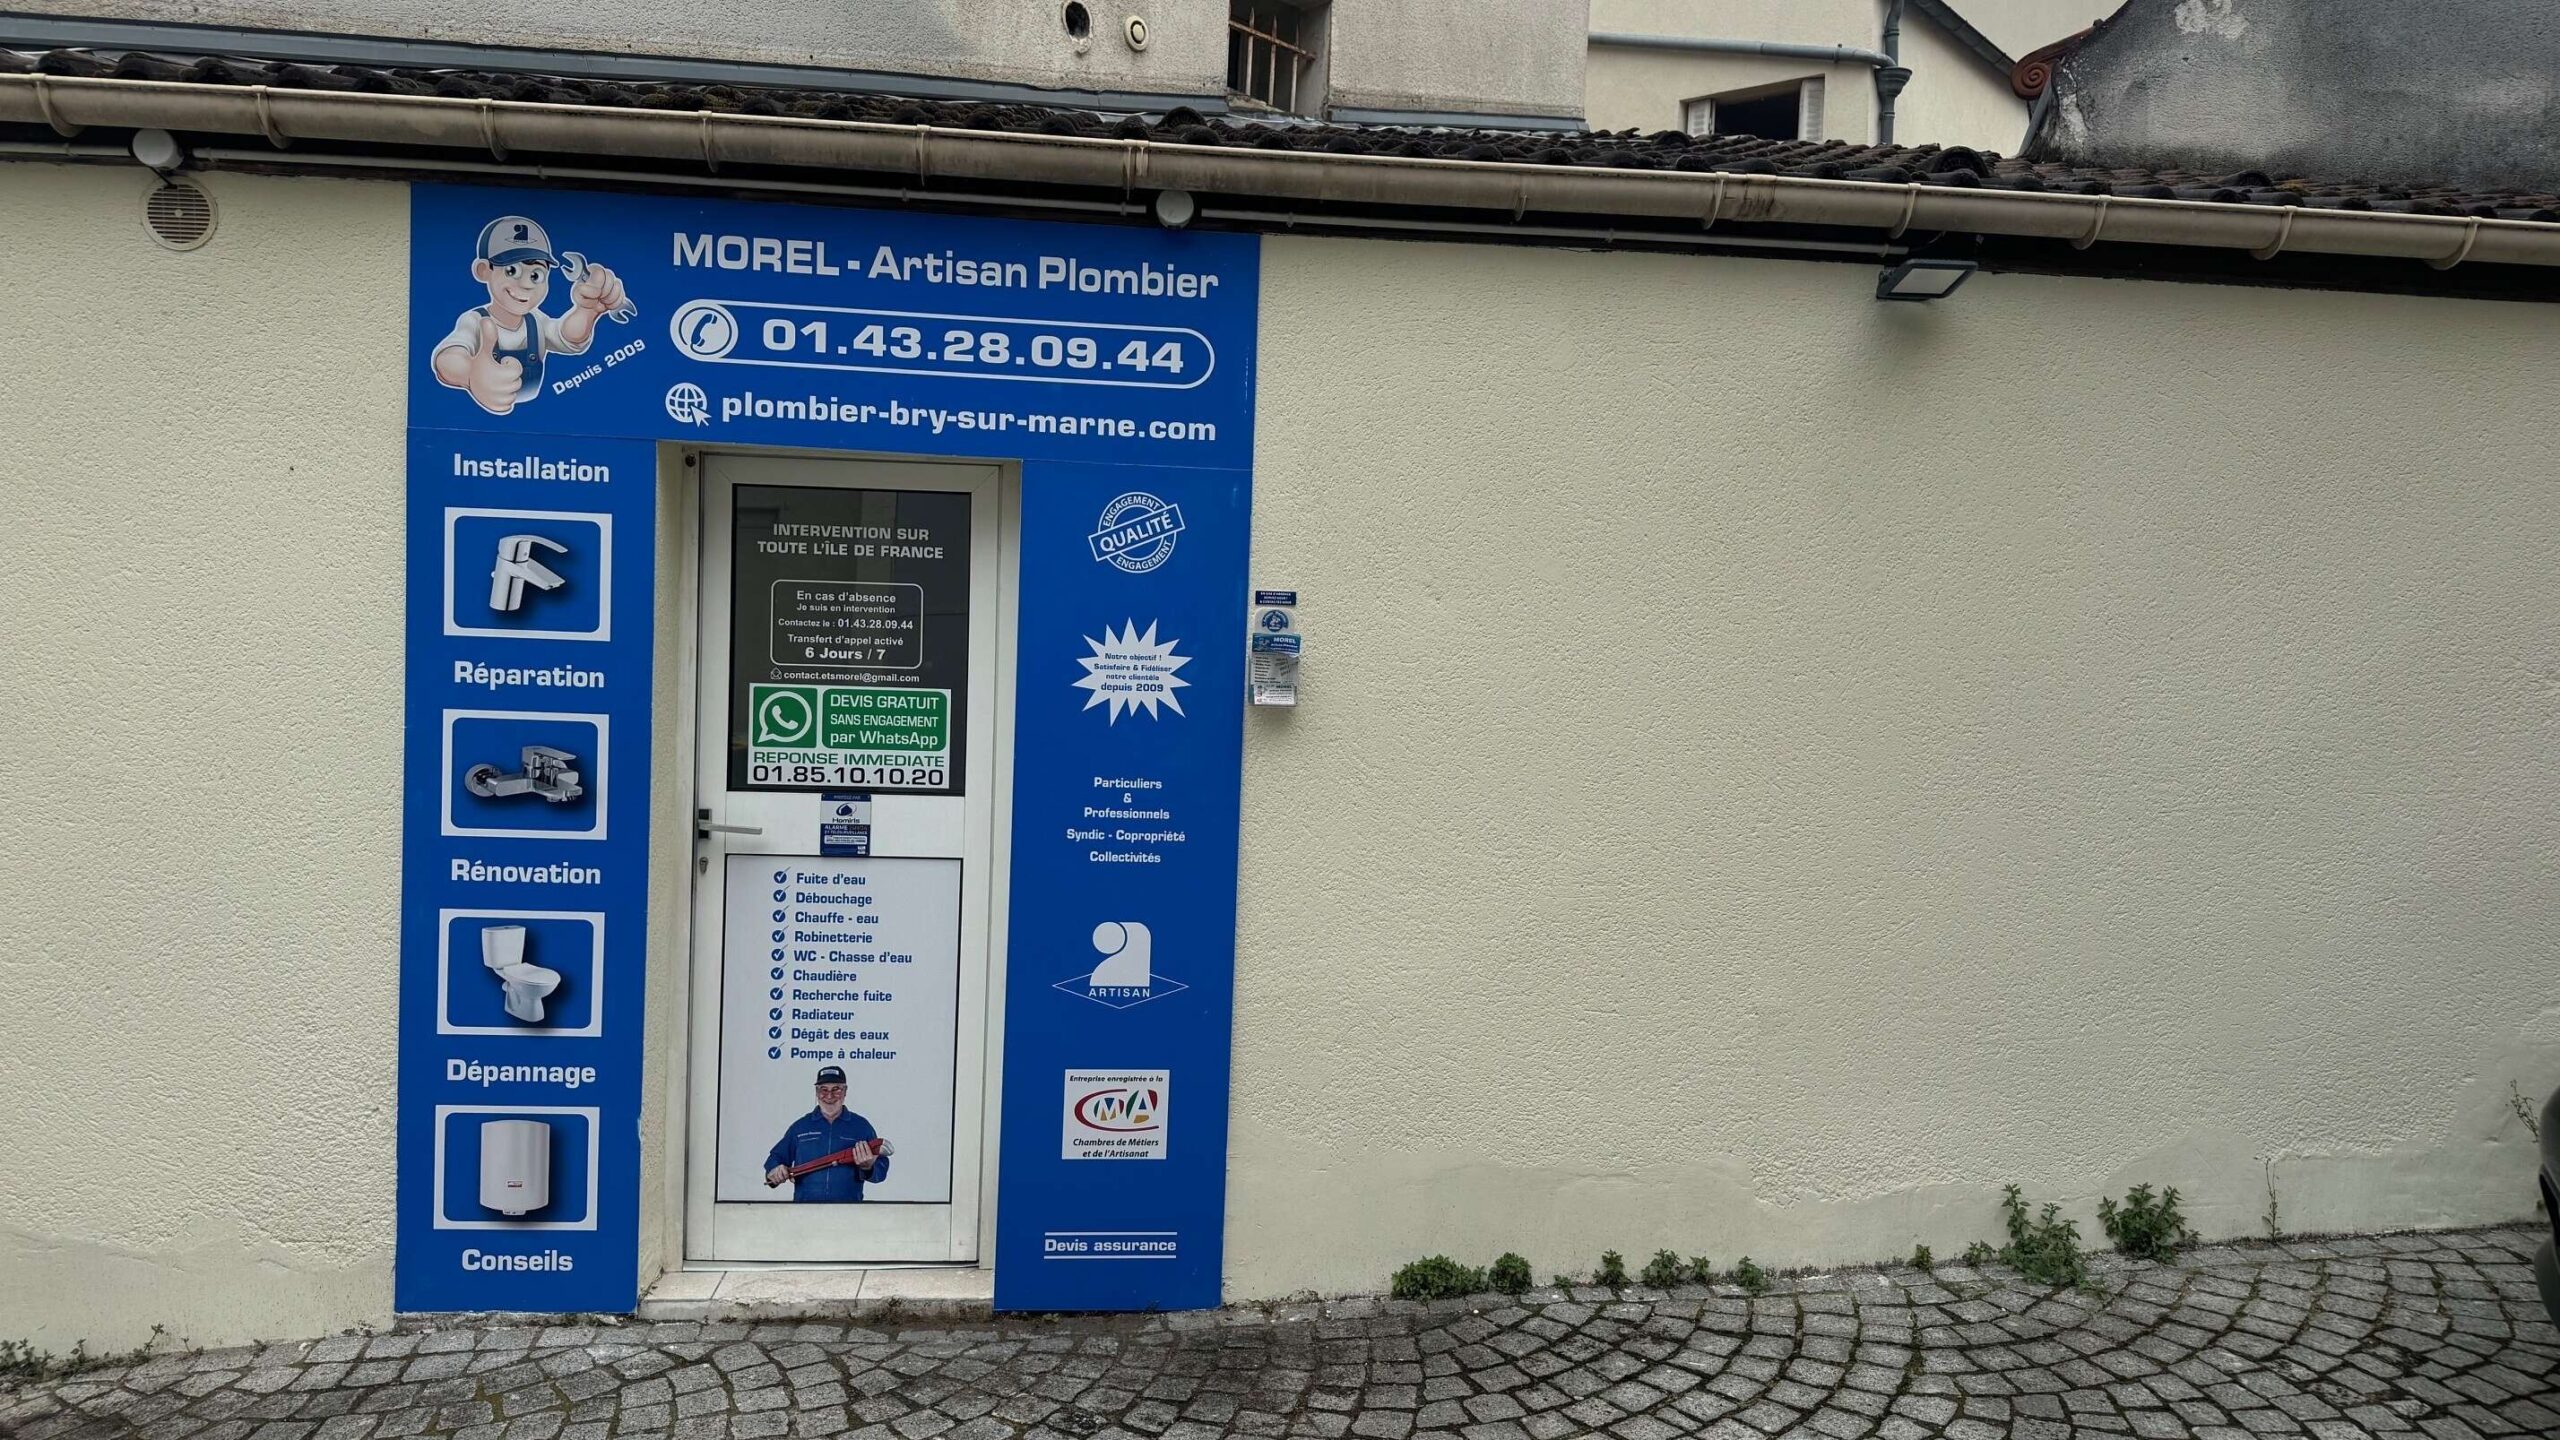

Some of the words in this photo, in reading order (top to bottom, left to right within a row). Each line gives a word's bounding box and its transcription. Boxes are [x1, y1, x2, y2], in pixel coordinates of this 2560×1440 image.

[672, 232, 840, 276] MOREL
[868, 245, 1029, 290] Artisan
[1038, 257, 1219, 299] Plombier
[763, 319, 1185, 375] 01.43.28.09.44
[552, 363, 603, 395] Depuis
[604, 338, 646, 368] 2009
[722, 393, 1217, 443] plombier-bry-sur-marne.com
[454, 453, 610, 482] Installation
[1102, 495, 1161, 528] ENGAGEMENT
[773, 524, 891, 540] INTERVENTION
[897, 528, 929, 541] SUR
[1099, 511, 1174, 553] QUALITÉ
[757, 541, 807, 556] TOUTE
[854, 544, 875, 557] DE
[880, 545, 944, 559] FRANCE
[1116, 540, 1172, 571] ENGAGEMENT
[797, 591, 812, 601] En
[815, 592, 835, 602] cas
[796, 604, 807, 612] Je
[809, 604, 828, 612] suis
[830, 605, 841, 613] en
[843, 604, 896, 614] intervention
[778, 619, 821, 628] Contactez
[837, 618, 913, 630] 01.43.28.09.44
[787, 634, 833, 644] Transfert
[874, 636, 904, 646] activé
[805, 647, 814, 658] 6
[819, 647, 863, 660] Jours
[876, 649, 886, 660] 7
[1105, 653, 1127, 661] Notre
[1129, 653, 1157, 662] objectif
[1094, 663, 1130, 671] Satisfaire
[1141, 663, 1172, 672] Fidéliser
[454, 660, 605, 691] Réparation
[783, 670, 920, 683] contact.etsmorel@gmail.com
[1100, 682, 1132, 693] depuis
[1136, 683, 1163, 693] 2009
[830, 694, 873, 708] DEVIS
[877, 696, 940, 709] GRATUIT
[830, 714, 861, 726] SANS
[863, 715, 939, 728] ENGAGEMENT
[830, 733, 856, 747] par
[860, 731, 938, 749] WhatsApp
[754, 752, 838, 765] REPONSE
[844, 754, 944, 767] IMMEDIATE
[753, 765, 944, 786] 01.85.10.10.20
[1093, 777, 1162, 790] Particuliers
[1123, 793, 1132, 803] &
[1084, 807, 1170, 820] Professionnels
[1066, 828, 1105, 842] Syndic
[1116, 828, 1185, 844] Copropriété
[1090, 851, 1161, 863] Collectivités
[451, 859, 601, 885] Rénovation
[796, 873, 828, 885] Fuite
[832, 873, 866, 886] d'eau
[796, 892, 872, 907] Débouchage
[795, 911, 844, 924] Chauffe
[856, 914, 879, 924] eau
[794, 931, 873, 944] Robinetterie
[794, 951, 817, 963] WC
[829, 951, 875, 964] Chasse
[879, 951, 912, 964] d'eau
[793, 969, 857, 982] Chaudière
[792, 989, 859, 1002] Recherche
[863, 990, 892, 1002] fuite
[1089, 987, 1151, 998] ARTISAN
[792, 1008, 854, 1021] Radiateur
[791, 1028, 829, 1043] Dégât
[833, 1028, 855, 1041] des
[860, 1031, 889, 1041] eaux
[790, 1047, 833, 1061] Pompe
[837, 1047, 845, 1060] à
[849, 1048, 897, 1061] chaleur
[447, 1059, 596, 1089] Dépannage
[1069, 1075, 1106, 1084] Entreprise
[1107, 1075, 1147, 1083] enregistrée
[1073, 1138, 1115, 1147] Chambres
[1117, 1138, 1126, 1147] de
[1128, 1138, 1159, 1147] Métiers
[1082, 1150, 1090, 1158] et
[1092, 1150, 1102, 1158] de
[1044, 1239, 1088, 1252] Devis
[1093, 1241, 1177, 1252] assurance
[461, 1249, 574, 1272] Conseils
